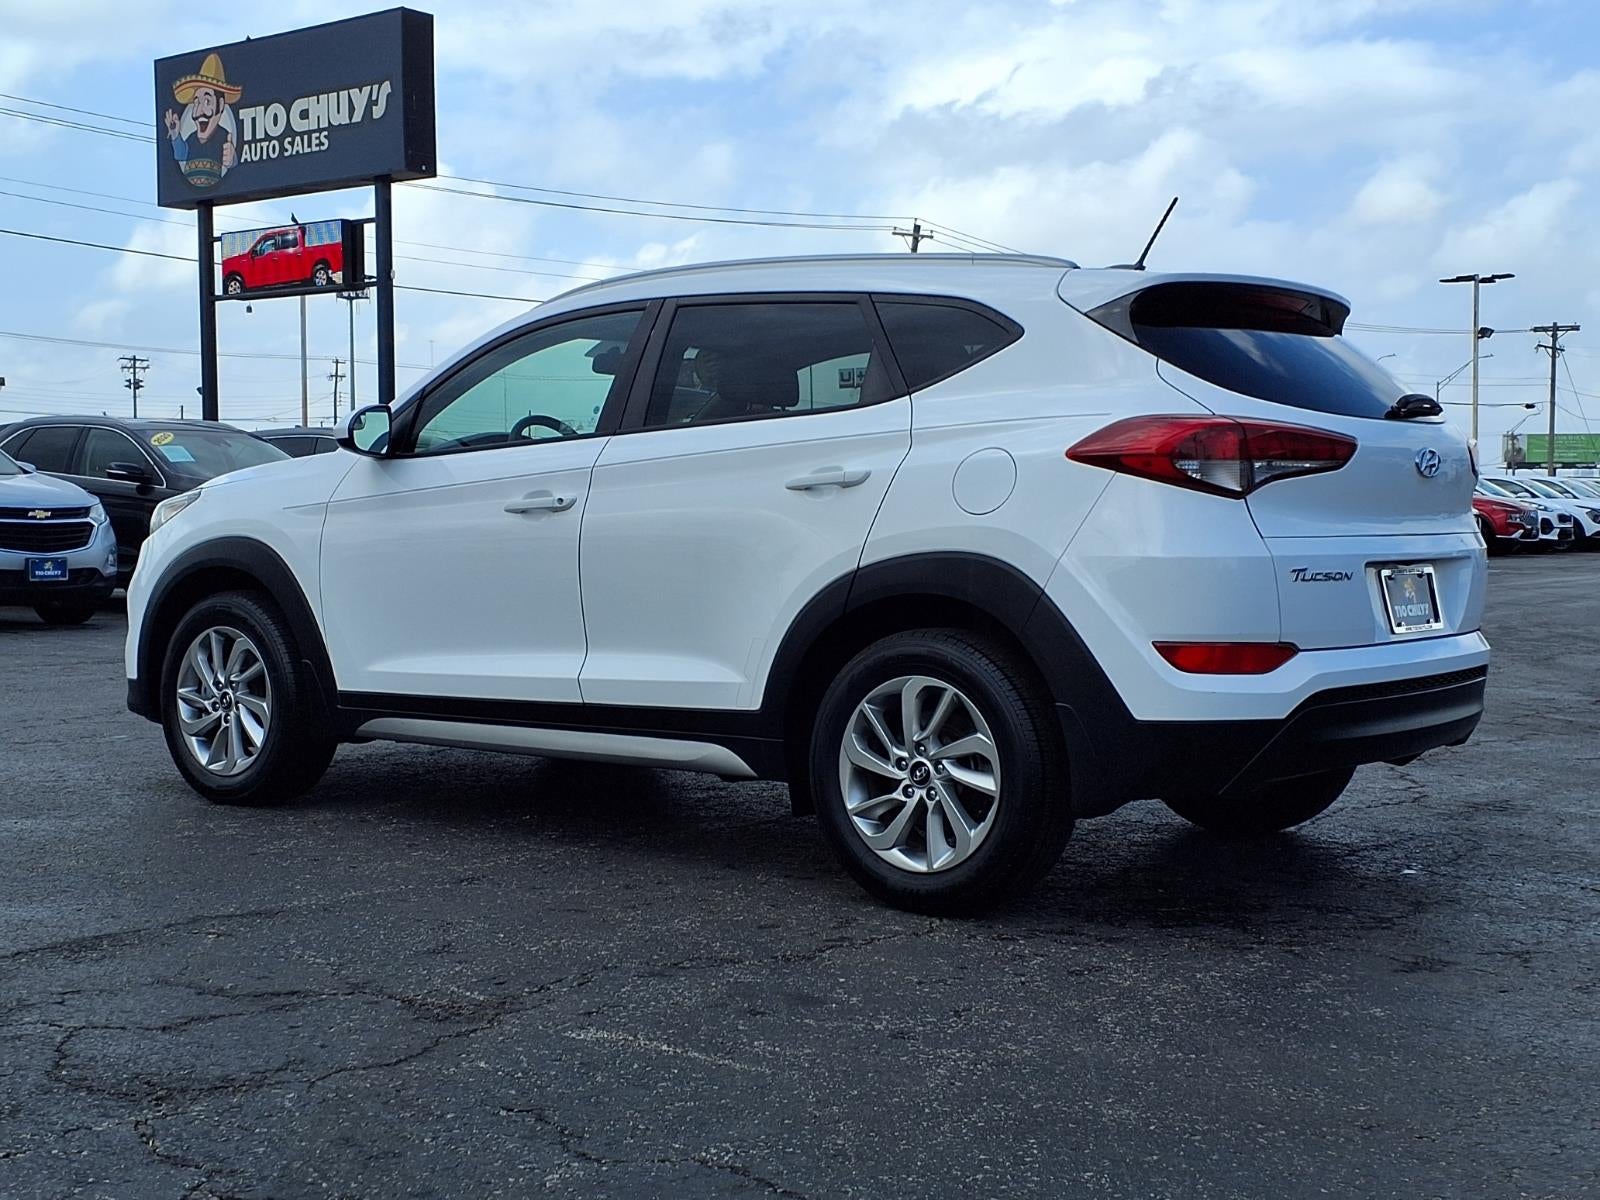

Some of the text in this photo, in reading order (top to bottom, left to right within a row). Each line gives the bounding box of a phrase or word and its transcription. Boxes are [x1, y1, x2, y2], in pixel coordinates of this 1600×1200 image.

[239, 80, 392, 141] TIO CHUY'S
[240, 131, 329, 163] AUTO SALES
[1394, 605, 1407, 618] TIO
